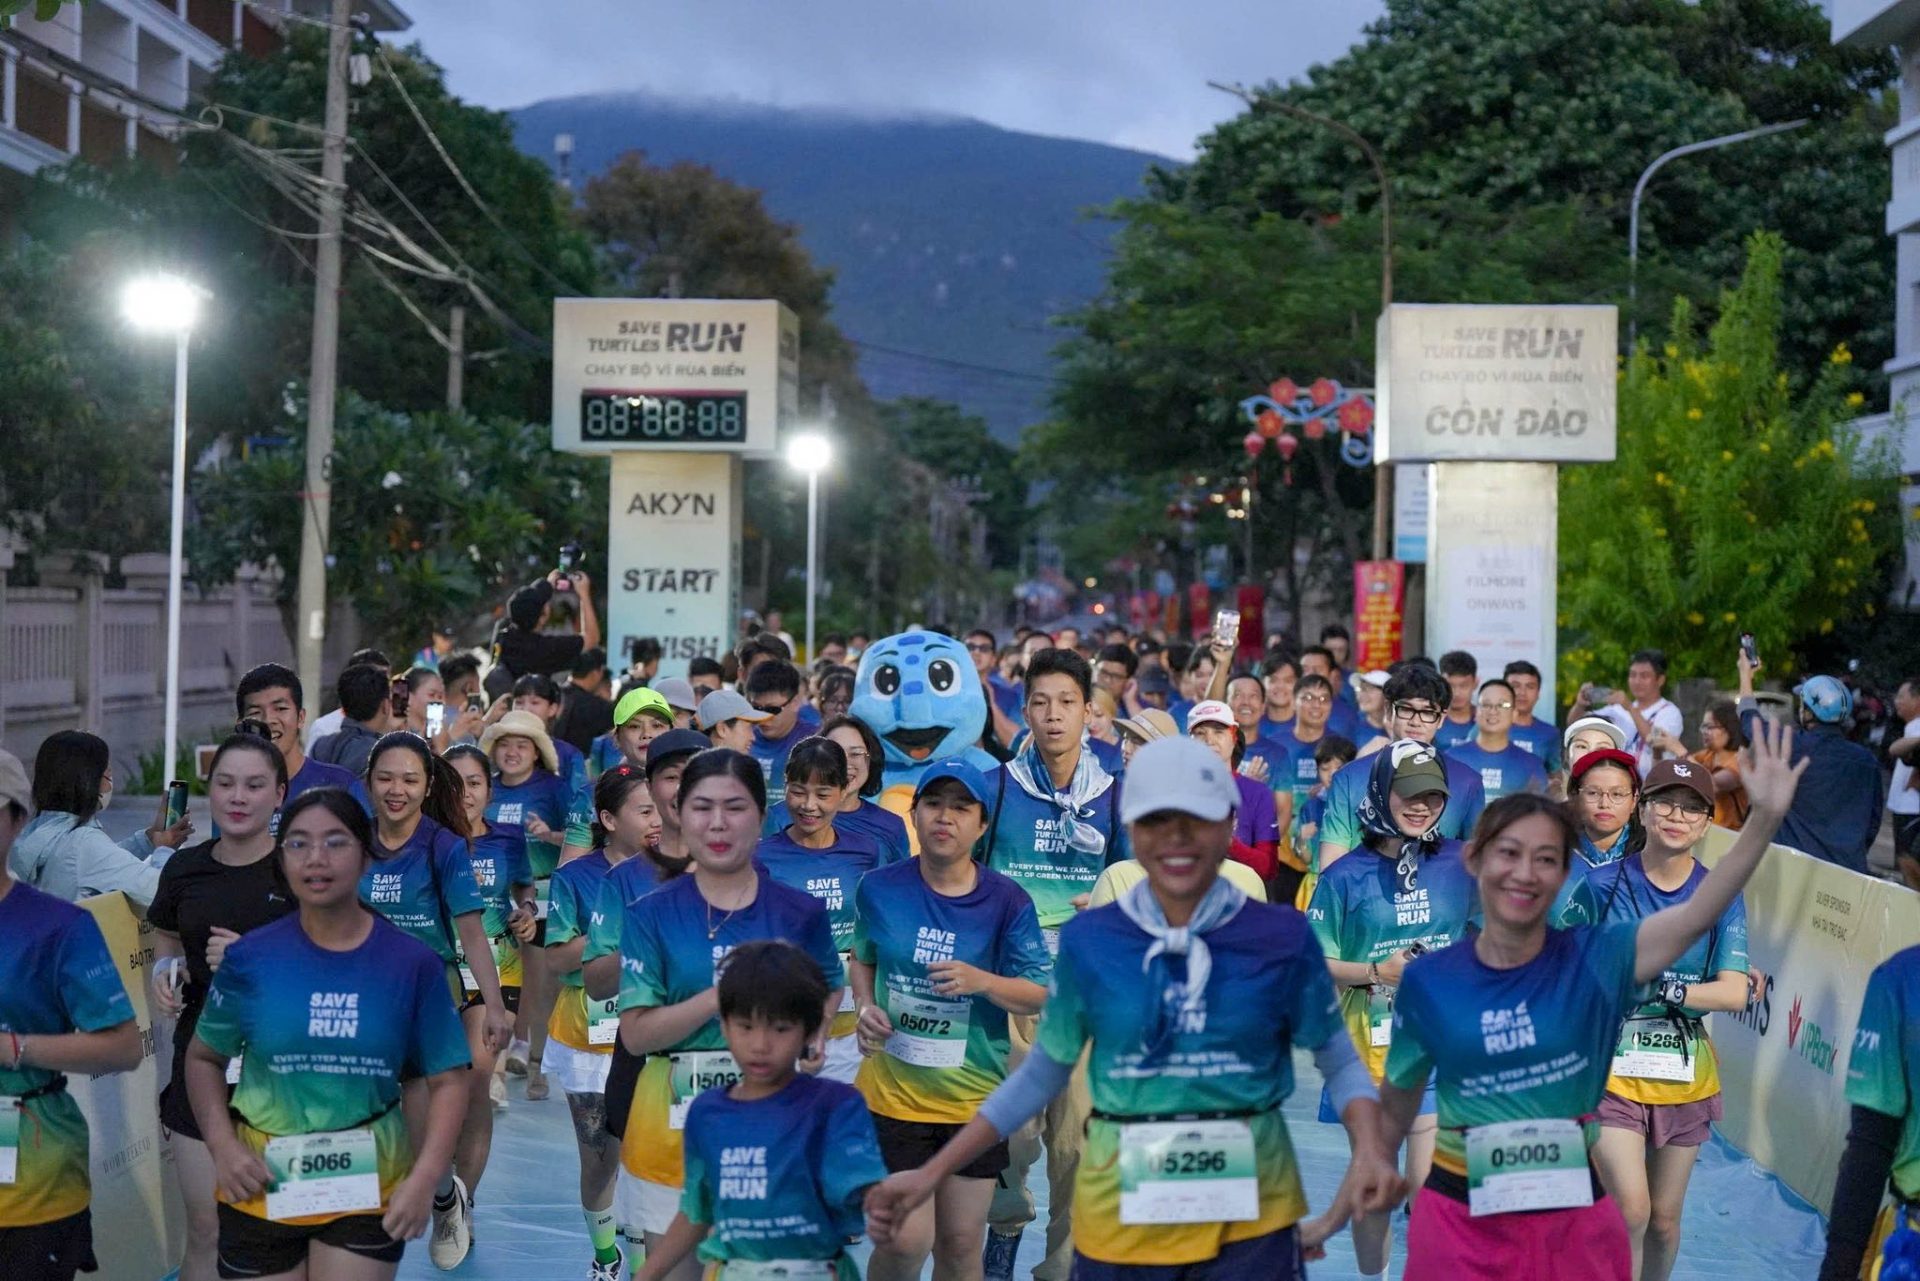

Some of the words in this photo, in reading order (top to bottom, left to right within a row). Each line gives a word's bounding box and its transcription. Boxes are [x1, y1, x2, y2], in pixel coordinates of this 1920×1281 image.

[619, 321, 661, 334] SAVE
[1454, 327, 1498, 341] SAVE
[667, 323, 746, 352] RUN
[1501, 328, 1585, 359] RUN
[588, 338, 660, 352] TURTLES
[1423, 345, 1497, 358] TURTLES
[1425, 398, 1504, 436] CÔN
[627, 492, 714, 516] AKYN
[623, 568, 719, 593] START
[1035, 818, 1061, 831] SAV
[1034, 838, 1067, 853] RUN
[470, 858, 494, 868] AVE
[1009, 862, 1033, 871] EVERY
[1034, 864, 1054, 872] STEP
[1055, 865, 1068, 873] WE
[372, 874, 402, 885] SAVE
[372, 882, 402, 891] TURTLES
[807, 877, 840, 890] SAVE
[370, 890, 402, 903] RUN
[808, 889, 842, 898] URTLES
[1393, 889, 1428, 904] SAVE
[1394, 901, 1430, 912] TURTLES
[414, 920, 435, 928] MAKE
[1397, 909, 1430, 926] RUN
[918, 926, 956, 945] SAVE
[916, 939, 954, 954] TURTLES
[1374, 939, 1398, 950] EVERY
[1663, 970, 1678, 979] WE
[310, 991, 360, 1008] SAVE
[308, 1019, 359, 1038] RUN
[900, 1012, 951, 1035] 05072
[1484, 1024, 1536, 1055] RUN
[272, 1054, 308, 1064] EVERY
[310, 1054, 338, 1063] STEP
[340, 1055, 358, 1064] WE
[296, 1063, 311, 1072] OF
[312, 1064, 348, 1075] GREEN
[350, 1065, 368, 1075] WE
[1528, 1062, 1549, 1075] WE
[689, 1072, 746, 1091] 0509
[720, 1146, 767, 1165] SAVE
[1491, 1143, 1561, 1167] 05003
[719, 1178, 768, 1200] RUN
